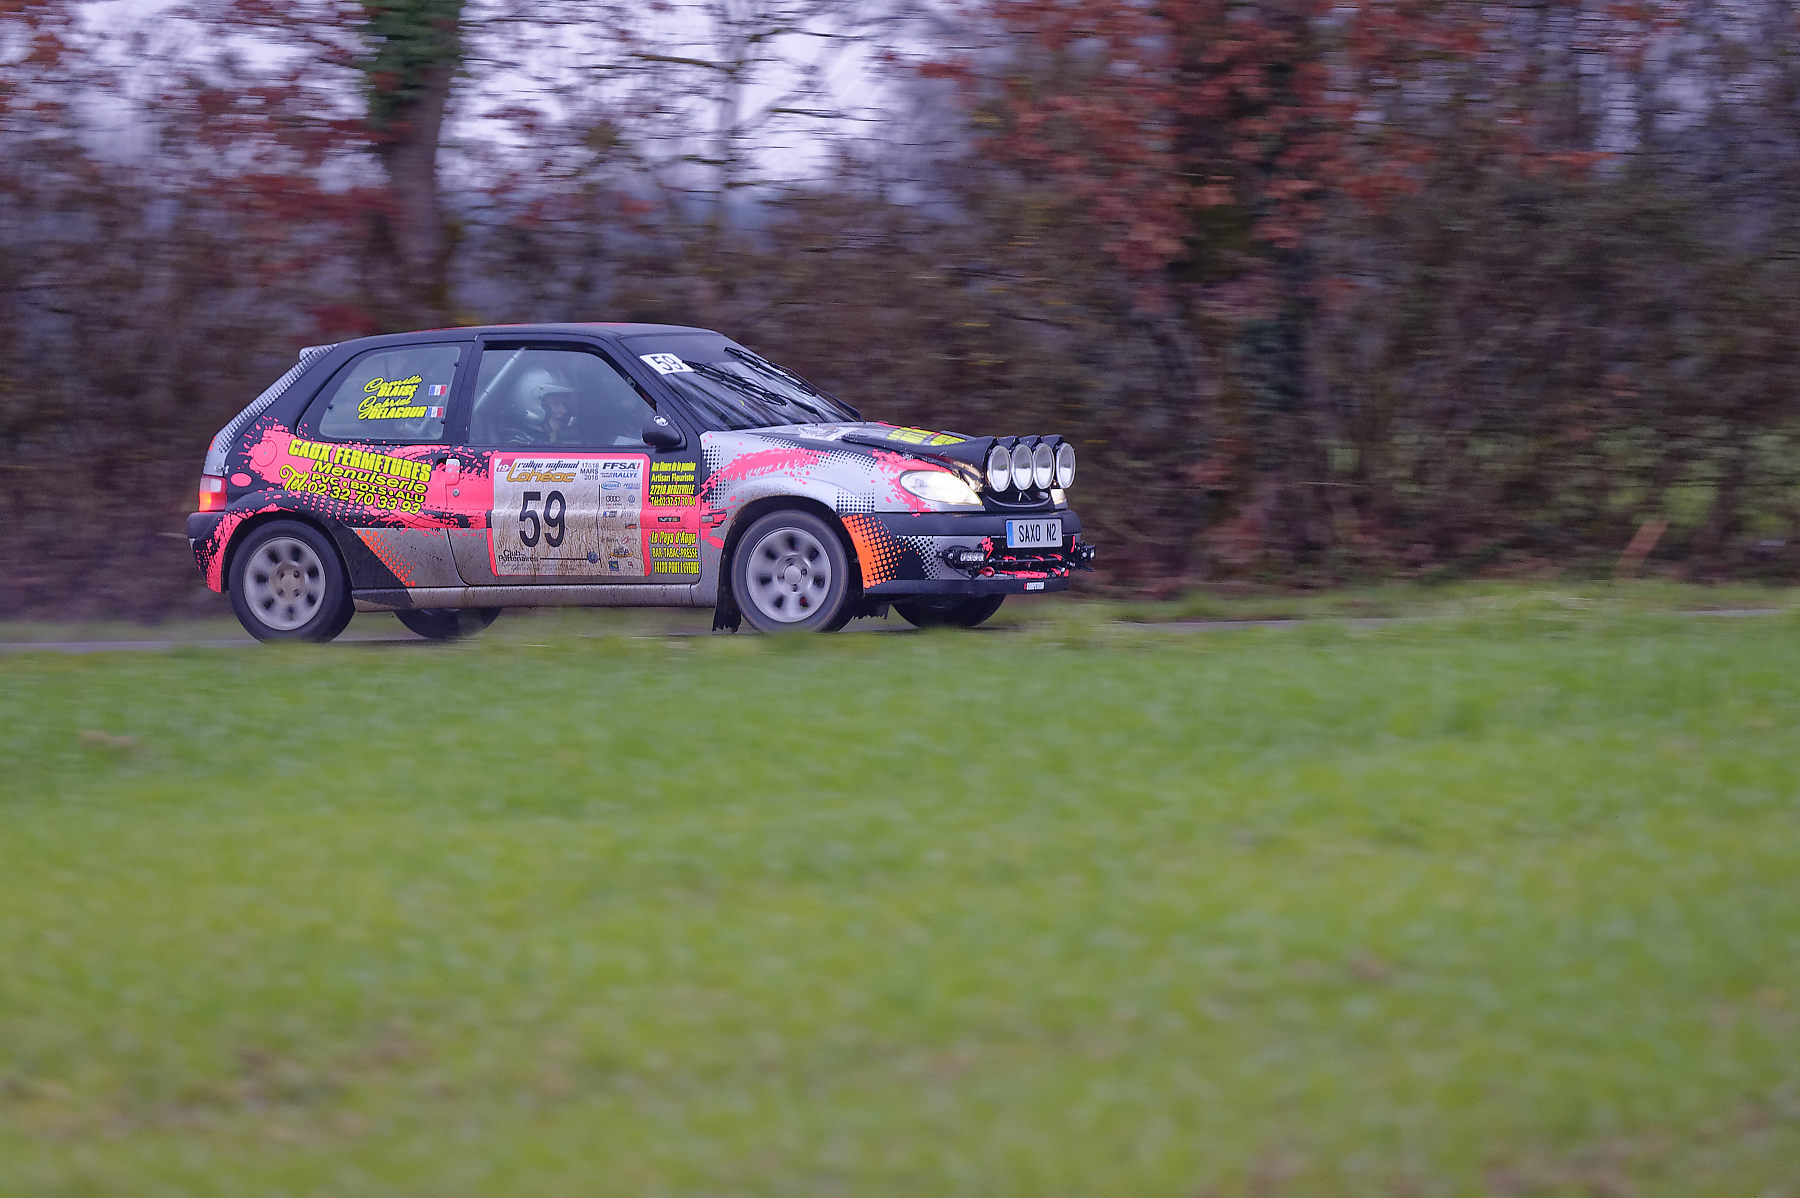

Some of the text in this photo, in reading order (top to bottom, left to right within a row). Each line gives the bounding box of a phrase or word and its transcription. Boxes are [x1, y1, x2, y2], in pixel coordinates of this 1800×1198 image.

[650, 355, 684, 371] 59
[376, 384, 418, 397] BLAISE
[367, 406, 428, 420] DELACOUR
[288, 439, 432, 482] CAUX FERMETURES
[517, 460, 580, 470] rallye national
[312, 460, 428, 494] Menuiserie
[651, 473, 695, 482] Artisan Fleuriste
[310, 473, 425, 504] PVC BOIS ALU
[330, 486, 350, 502] 32
[354, 492, 376, 506] 70
[376, 495, 398, 510] 33
[400, 500, 422, 515] 93
[667, 496, 674, 506] 32
[674, 496, 680, 506] 57
[518, 490, 567, 548] 59
[651, 530, 658, 544] Le
[659, 530, 674, 546] Pays
[1018, 524, 1057, 542] SAXO N2
[652, 547, 698, 559] BAR-TABAC-PRESSE
